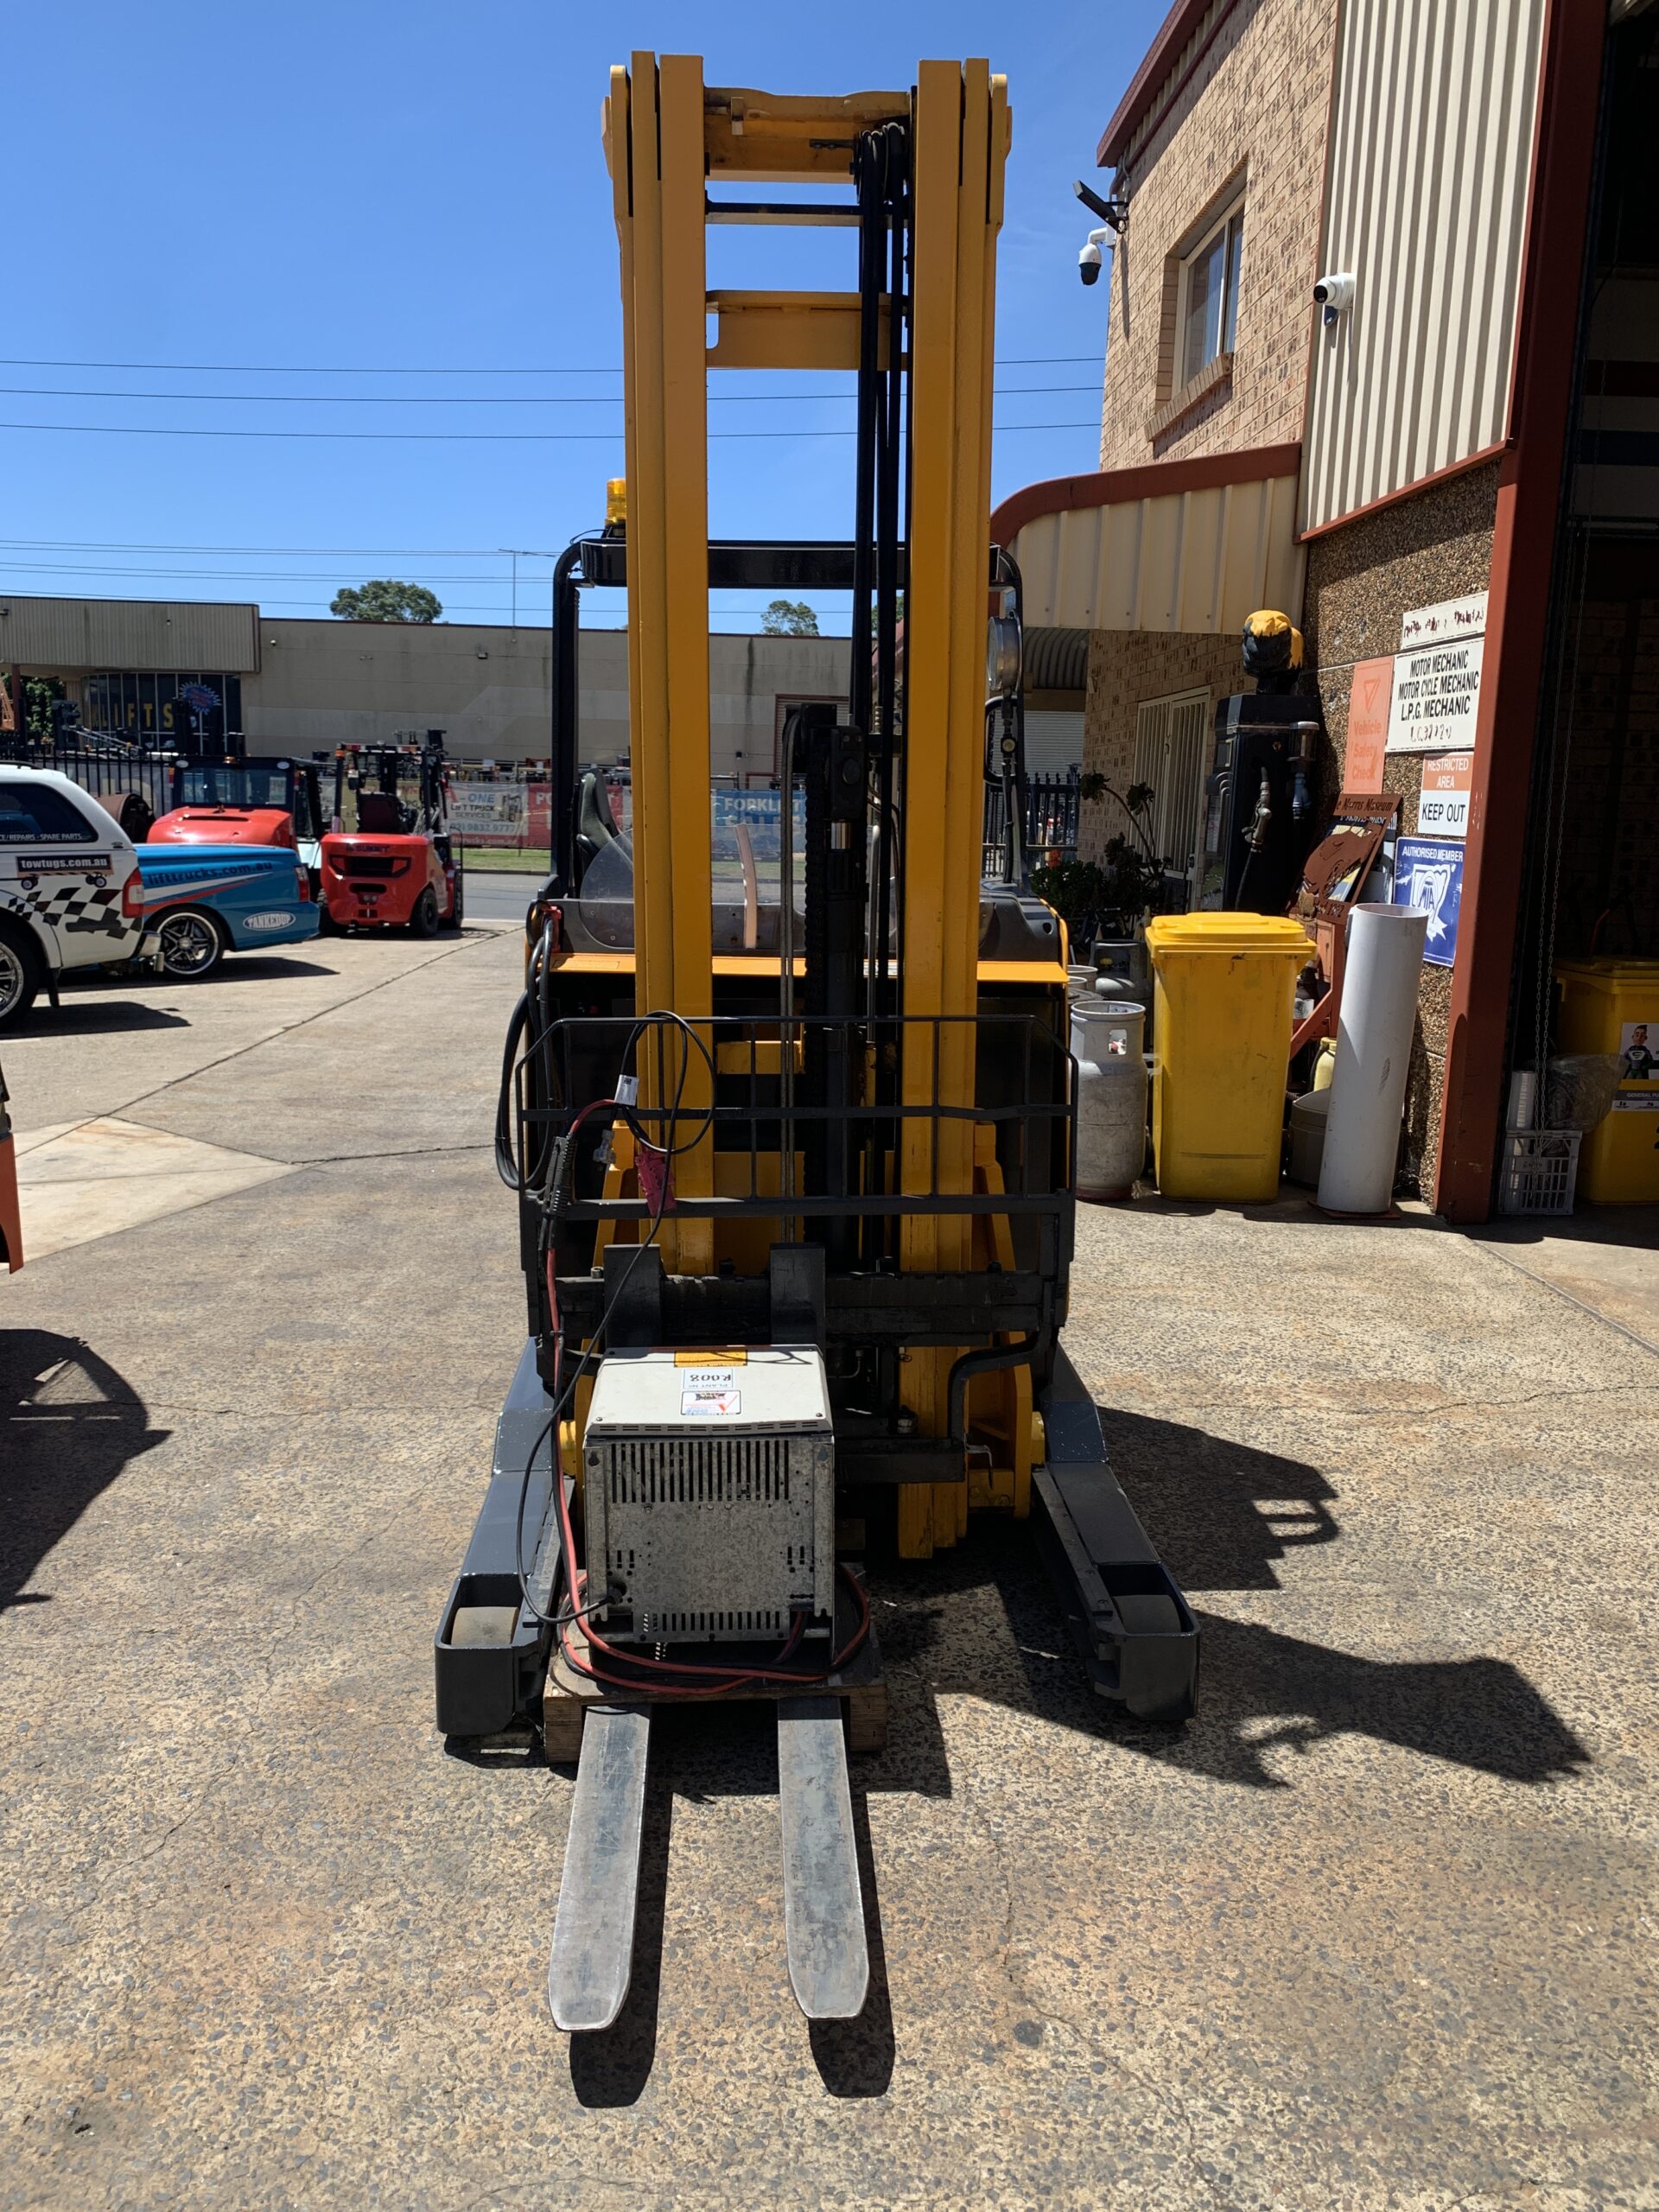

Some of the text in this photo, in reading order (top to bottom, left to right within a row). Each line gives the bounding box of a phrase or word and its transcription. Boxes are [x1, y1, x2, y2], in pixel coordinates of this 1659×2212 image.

[1409, 650, 1469, 678] MOTOR MECHANIC
[1398, 671, 1479, 701] MOTOR CYCLE MECHANIC
[1401, 695, 1471, 721] L.P.G. MECHANIC
[1354, 719, 1382, 736] Vehicle
[1354, 743, 1377, 758] Safety
[1352, 765, 1376, 779] Check
[1427, 758, 1469, 772] RESTRICTED
[1437, 775, 1455, 788] AREA
[723, 798, 800, 811] FORKLIT
[1364, 798, 1394, 811] Museum
[1421, 804, 1466, 823] KEEP OUT
[1402, 846, 1463, 861] AUTHORISED MEMBER
[21, 858, 108, 868] towtugs.com.au
[148, 861, 273, 885] lifttrucks.com.au
